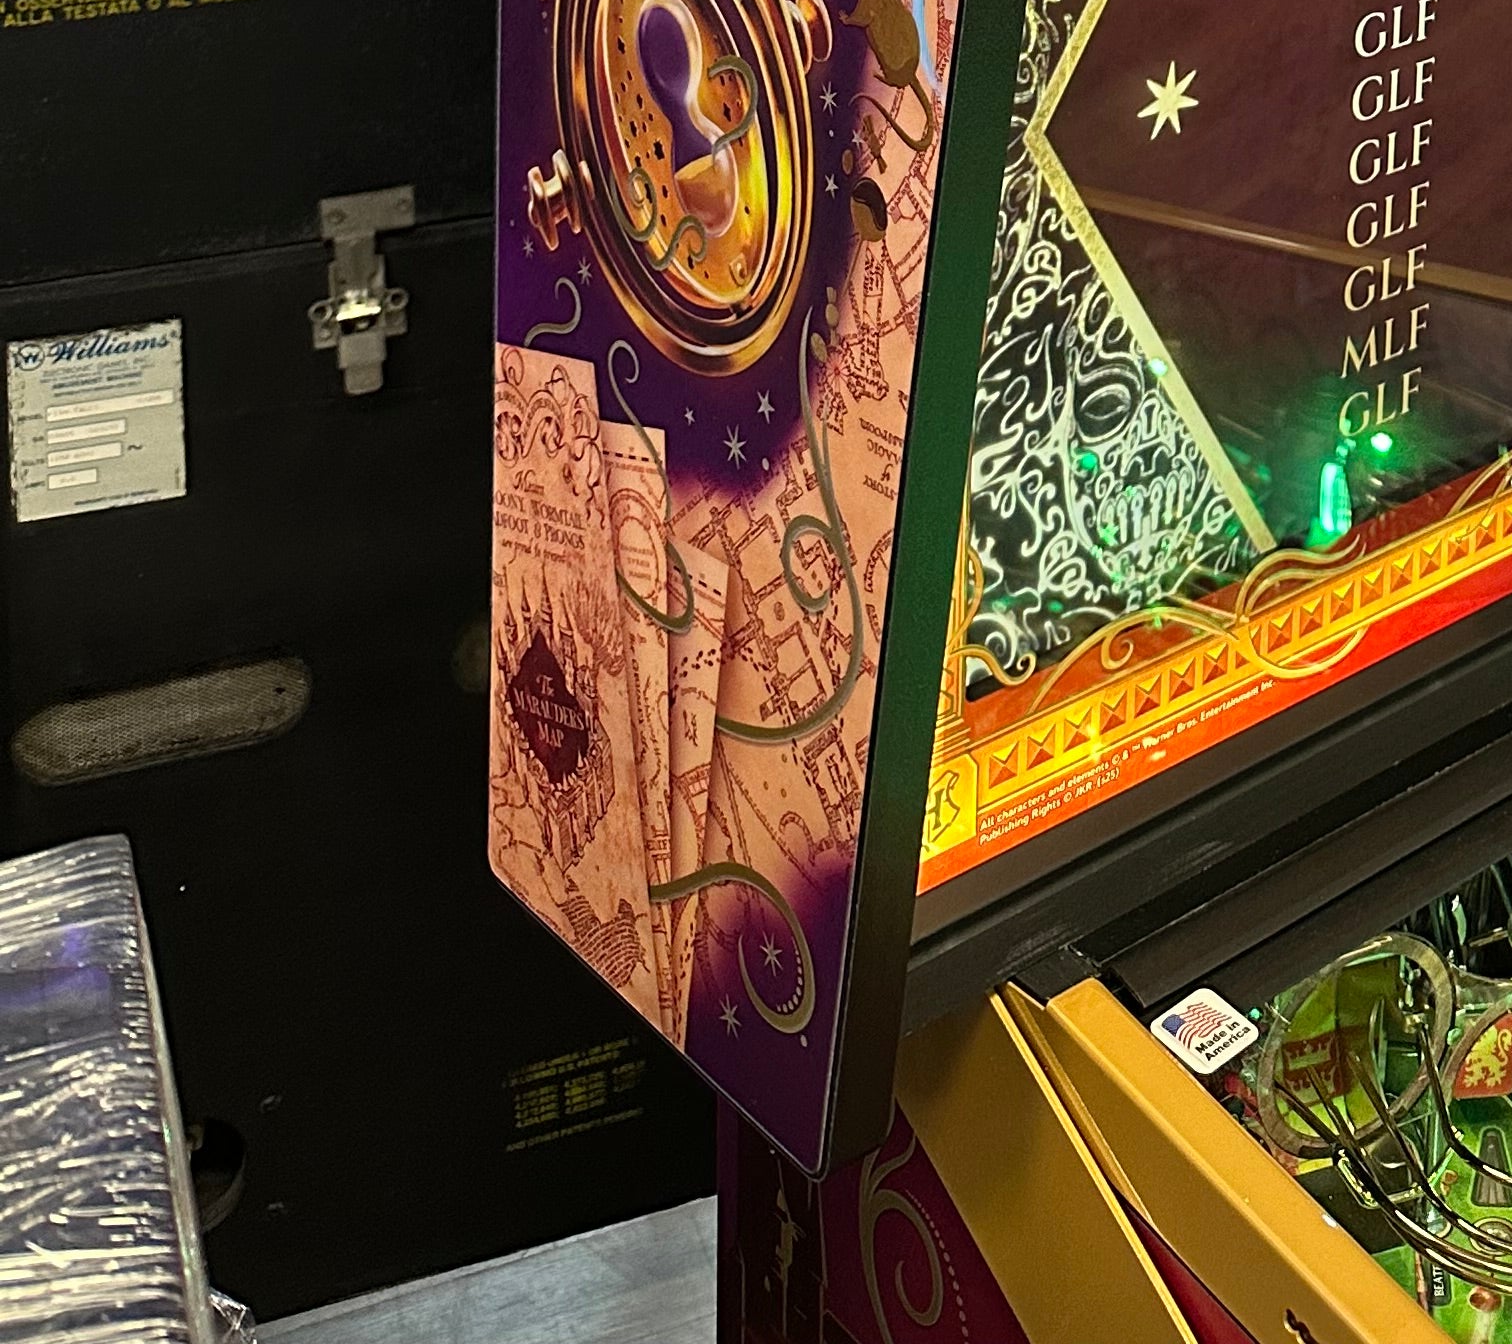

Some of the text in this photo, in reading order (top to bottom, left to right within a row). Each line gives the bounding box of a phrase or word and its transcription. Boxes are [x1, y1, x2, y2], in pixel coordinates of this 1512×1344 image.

[4, 10, 54, 28] ALLA
[62, 0, 141, 21] TESTATA
[1351, 57, 1436, 122] GLF
[1348, 119, 1433, 185] GLF
[1345, 182, 1430, 248] GLF
[1343, 244, 1428, 312] GLF
[48, 334, 170, 364] Williams
[1339, 304, 1430, 379] MLF
[1338, 367, 1422, 437] GLF
[495, 490, 525, 514] OONY
[863, 475, 898, 501] STORY
[537, 720, 565, 748] MAP
[980, 815, 995, 832] All
[996, 793, 1046, 824] characters
[1048, 780, 1066, 799] and
[1067, 761, 1109, 788] elements
[1142, 729, 1175, 752] Warner
[1200, 685, 1260, 722] Entertainment
[979, 814, 1030, 846] Publishing
[1031, 797, 1062, 821] Rights
[1194, 1020, 1242, 1055] Made in
[1204, 1025, 1252, 1062] America
[1432, 1265, 1446, 1298] BEAT
